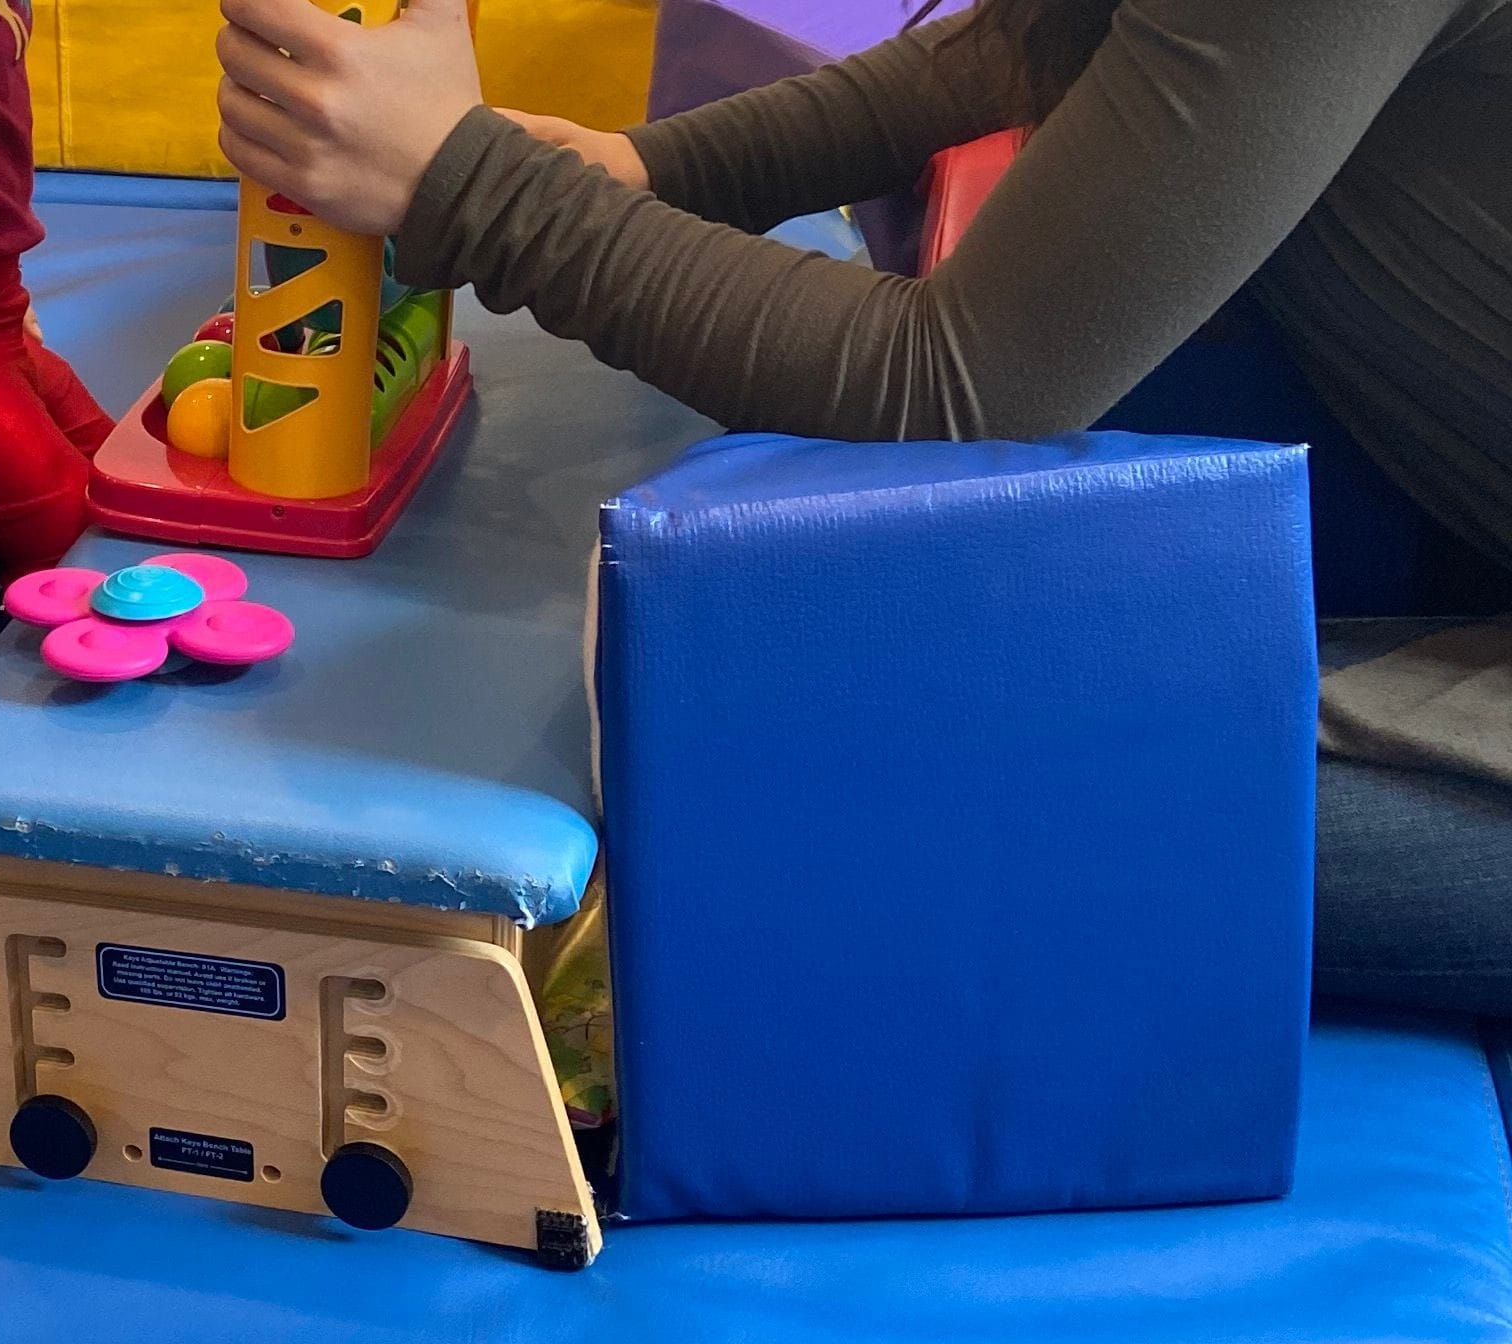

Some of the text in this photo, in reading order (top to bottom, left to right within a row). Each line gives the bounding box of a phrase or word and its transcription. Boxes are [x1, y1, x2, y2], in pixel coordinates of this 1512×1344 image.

[153, 1133, 252, 1155] Attach Kaye Bench Table
